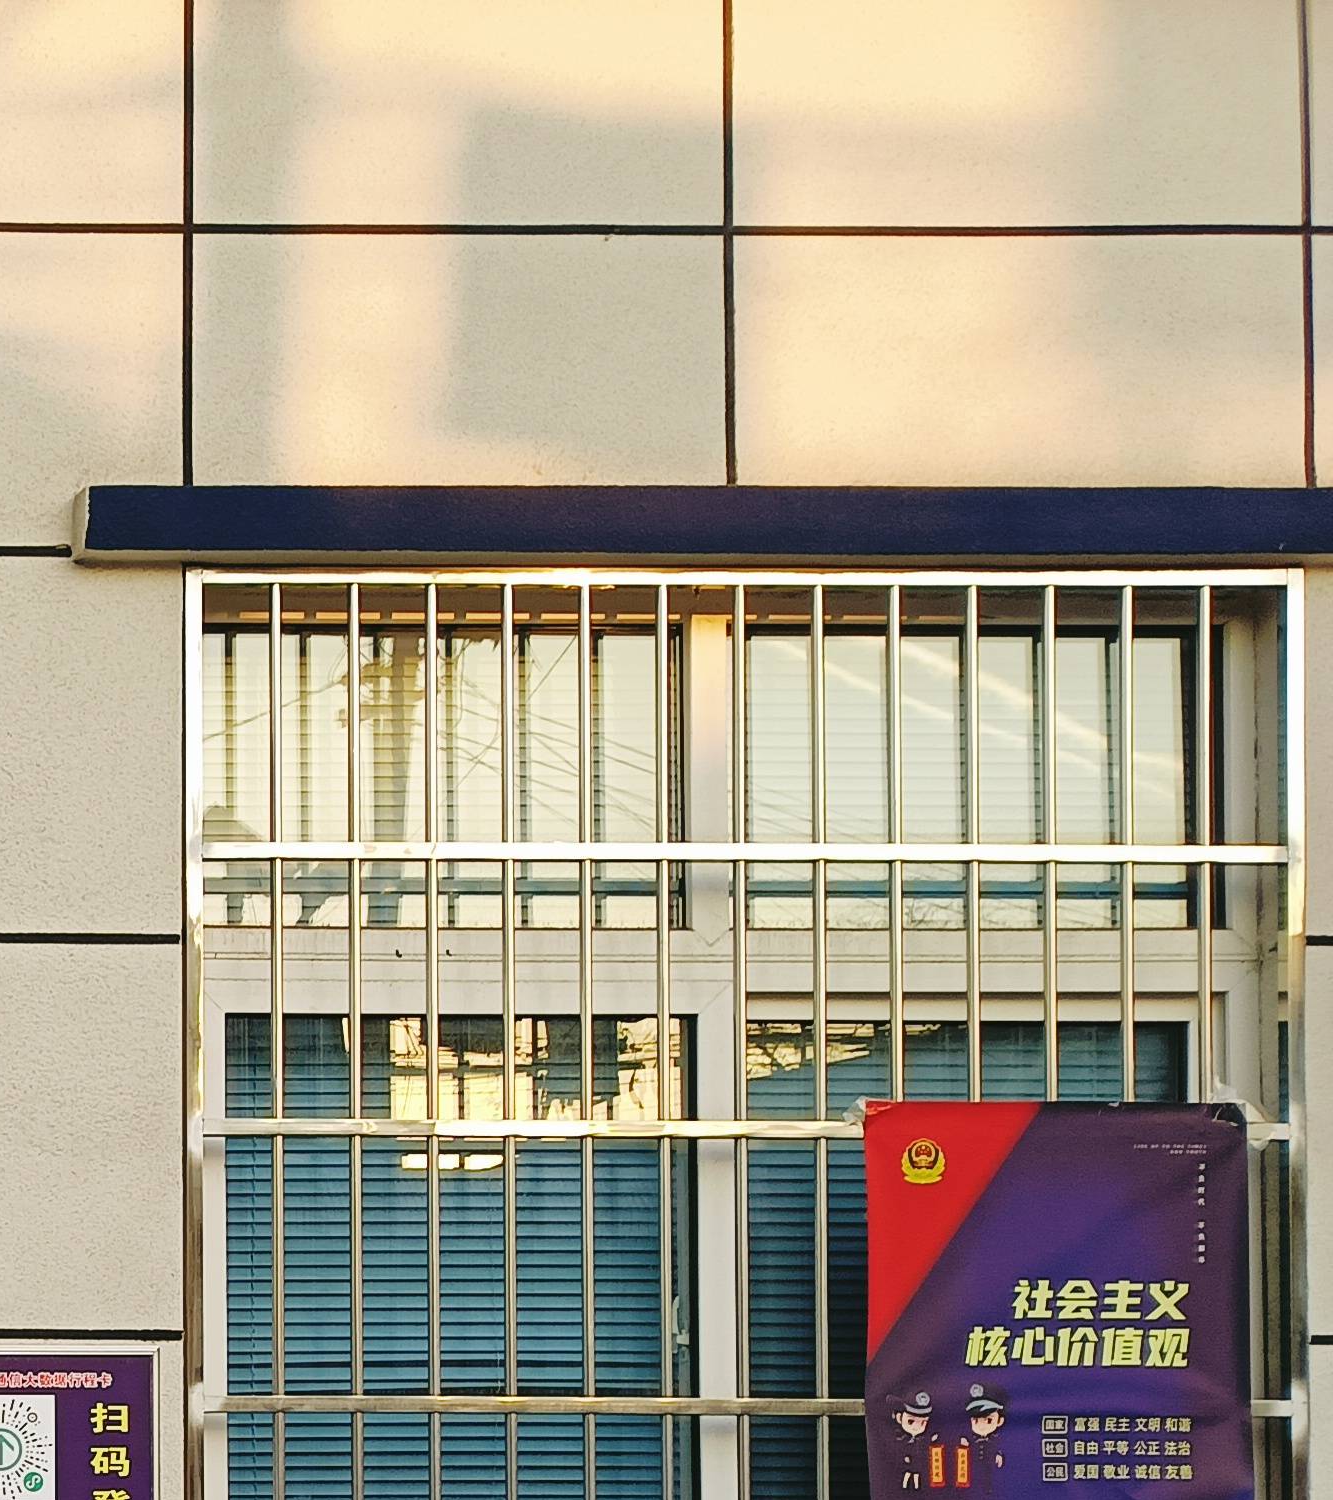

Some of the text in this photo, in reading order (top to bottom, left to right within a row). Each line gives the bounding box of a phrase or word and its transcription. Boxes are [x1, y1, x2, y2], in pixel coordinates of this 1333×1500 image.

[1011, 1279, 1190, 1320] 社会主义
[965, 1326, 1190, 1367] 核心价值观
[1074, 1417, 1100, 1432] 富强
[1104, 1417, 1131, 1432] 民主
[1134, 1417, 1161, 1432] 文明
[1164, 1417, 1192, 1432] 和谐
[1074, 1441, 1099, 1456] 自由
[1103, 1441, 1130, 1456] 平等
[1134, 1441, 1161, 1456] 公正
[1164, 1441, 1191, 1456] 法治
[1073, 1464, 1099, 1479] 爱国
[1103, 1464, 1131, 1479] 敬业
[1134, 1464, 1161, 1480] 诚信
[1165, 1464, 1193, 1480] 友善
